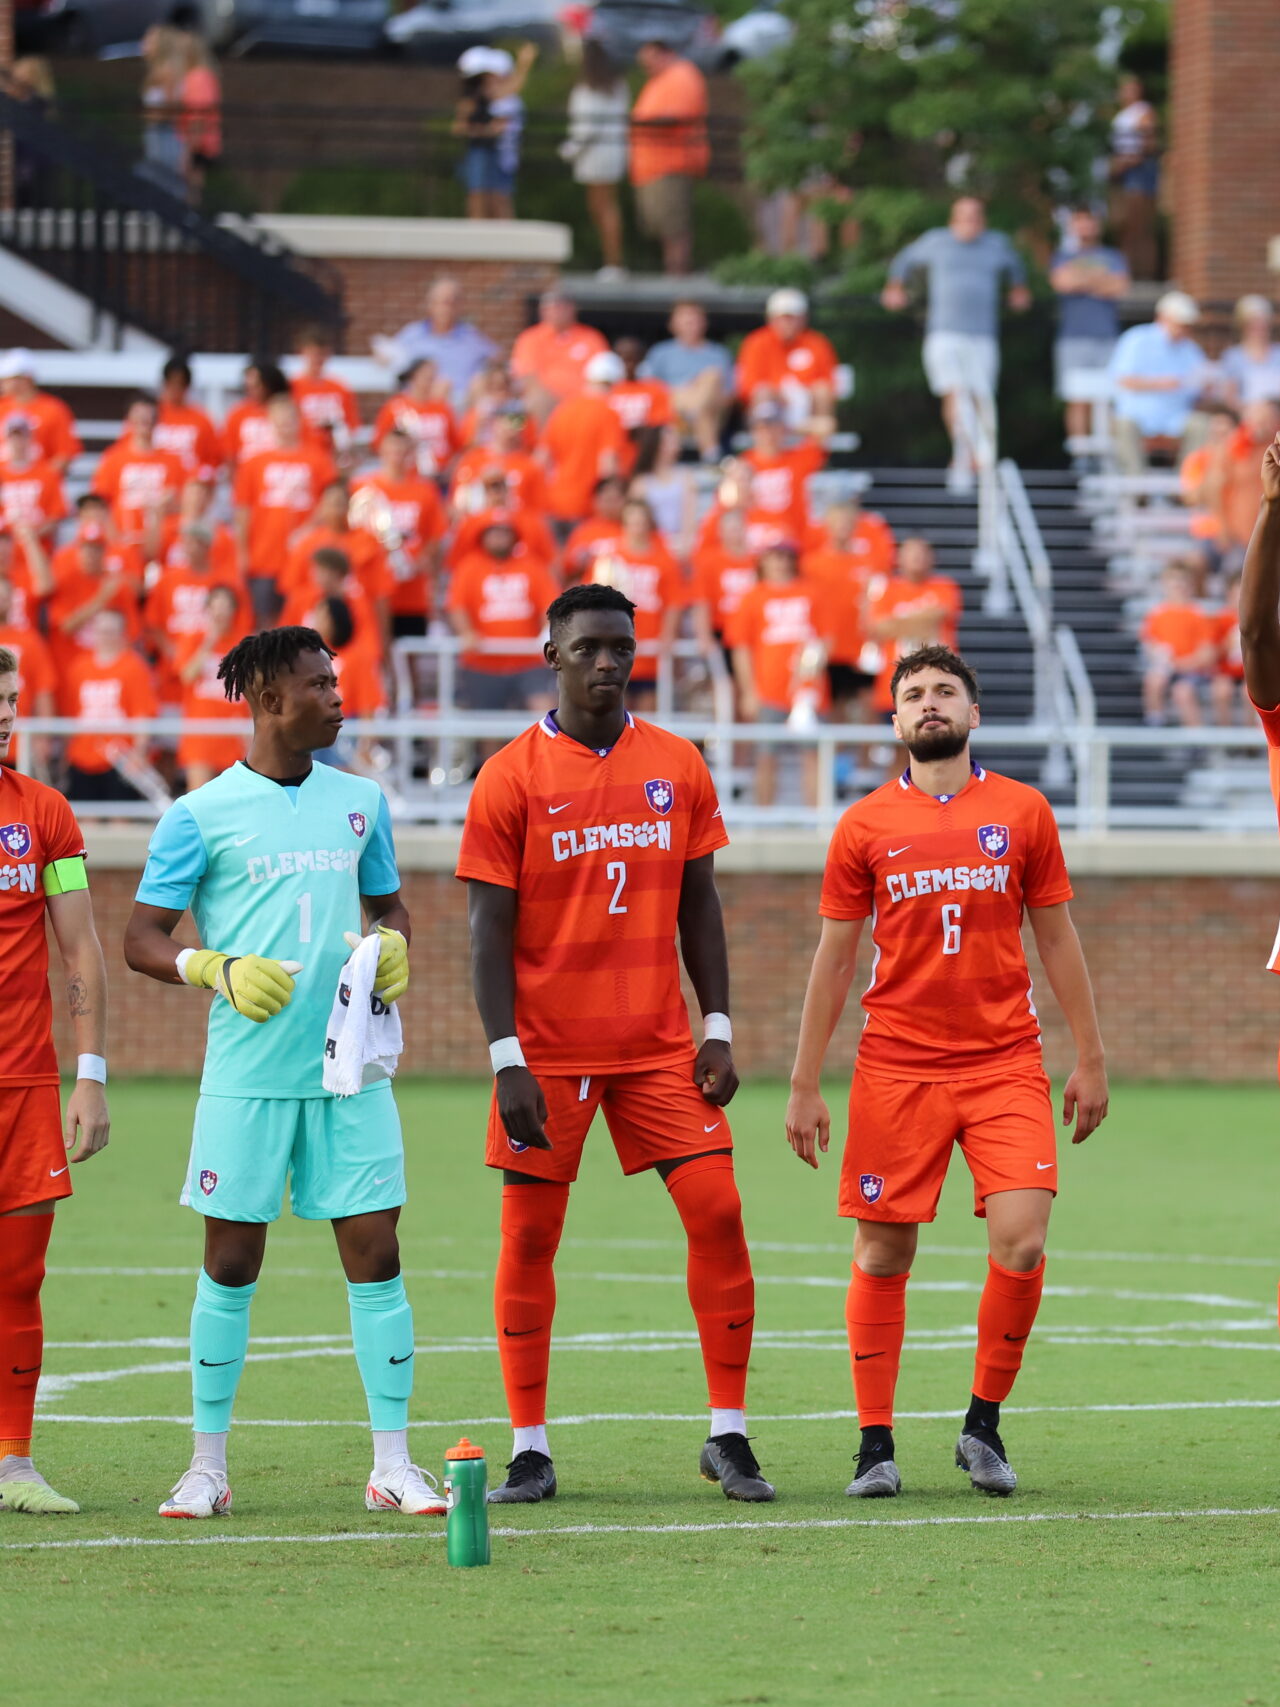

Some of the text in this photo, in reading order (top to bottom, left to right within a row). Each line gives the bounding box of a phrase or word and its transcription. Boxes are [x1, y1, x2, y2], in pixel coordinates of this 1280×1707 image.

[552, 821, 671, 862] CLEMSON
[606, 861, 628, 915] 2
[886, 864, 1010, 903] CLEMSON
[296, 891, 312, 943] 1
[941, 903, 961, 955] 6
